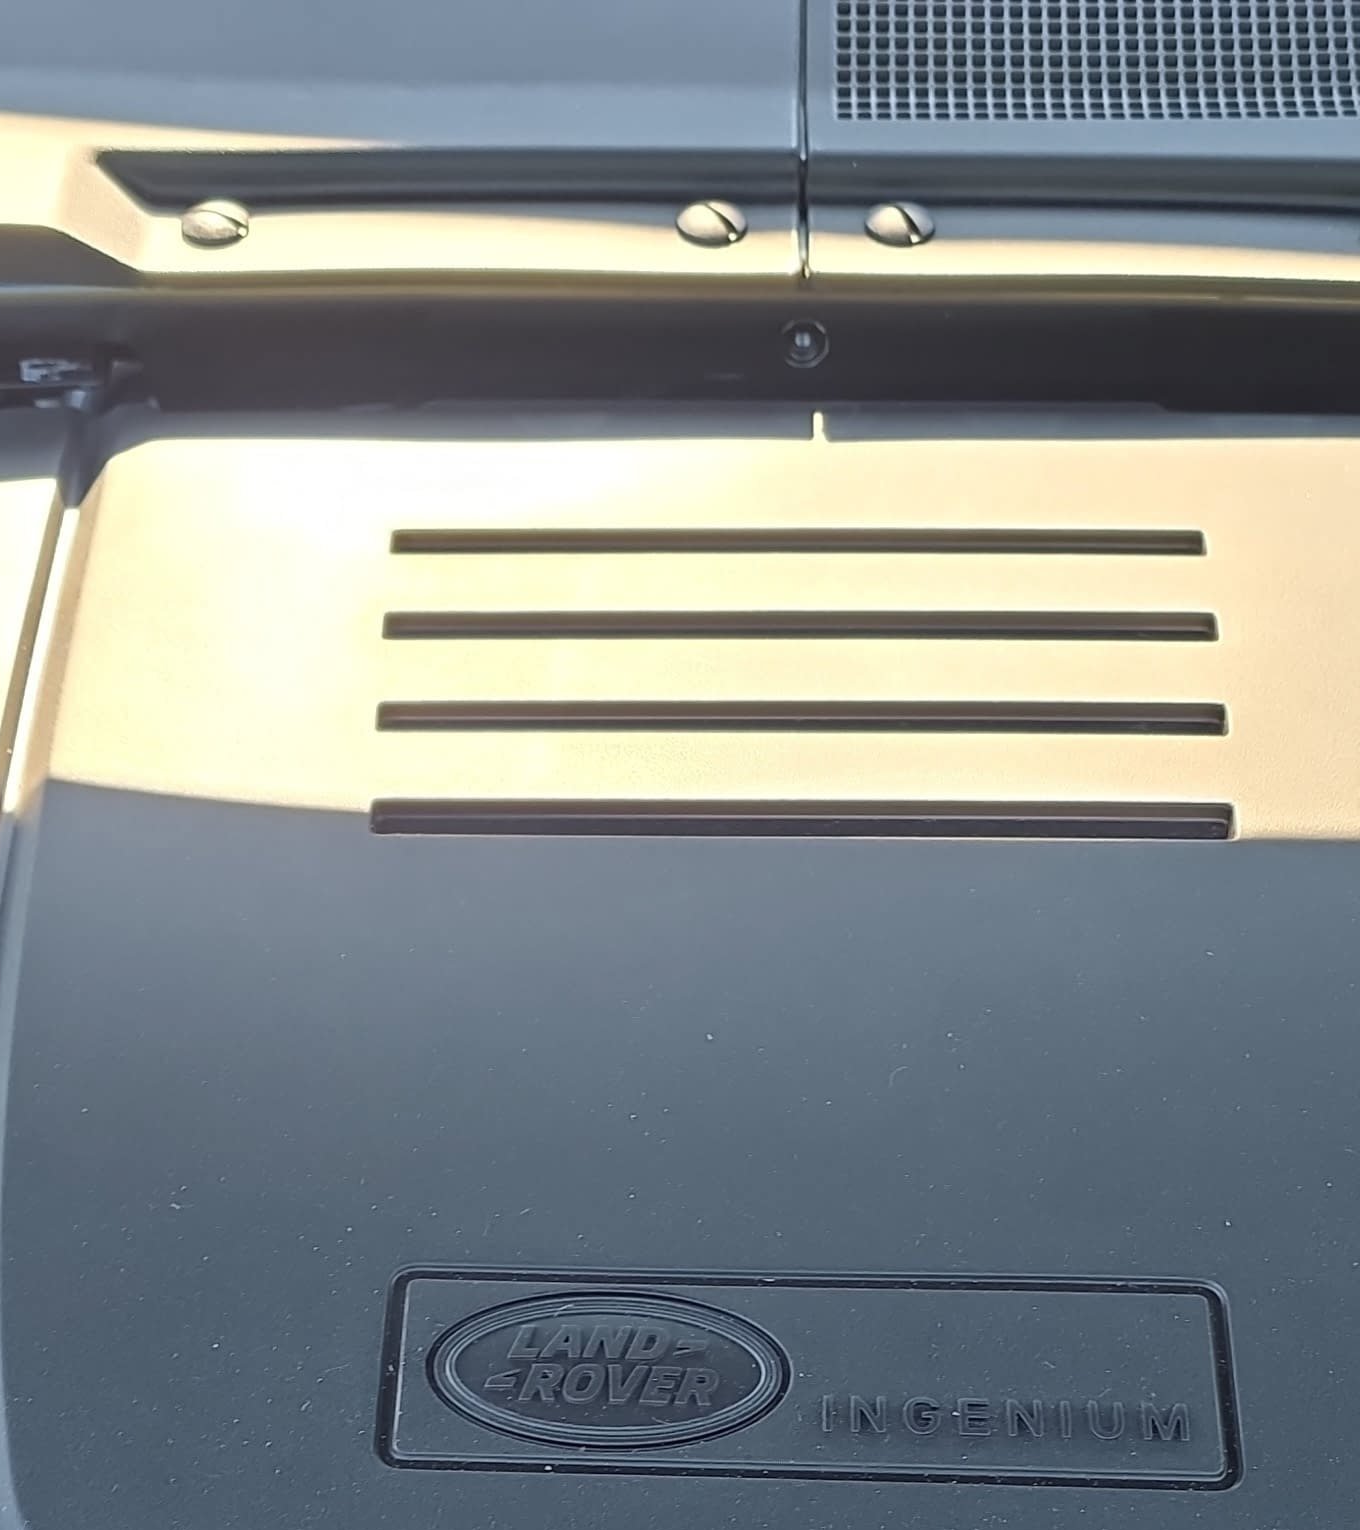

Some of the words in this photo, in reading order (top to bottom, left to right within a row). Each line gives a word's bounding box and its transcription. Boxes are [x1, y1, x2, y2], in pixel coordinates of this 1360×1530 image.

[507, 1324, 672, 1361] LAND
[517, 1363, 720, 1406] ROVER
[821, 1394, 1192, 1442] INGENIUM
